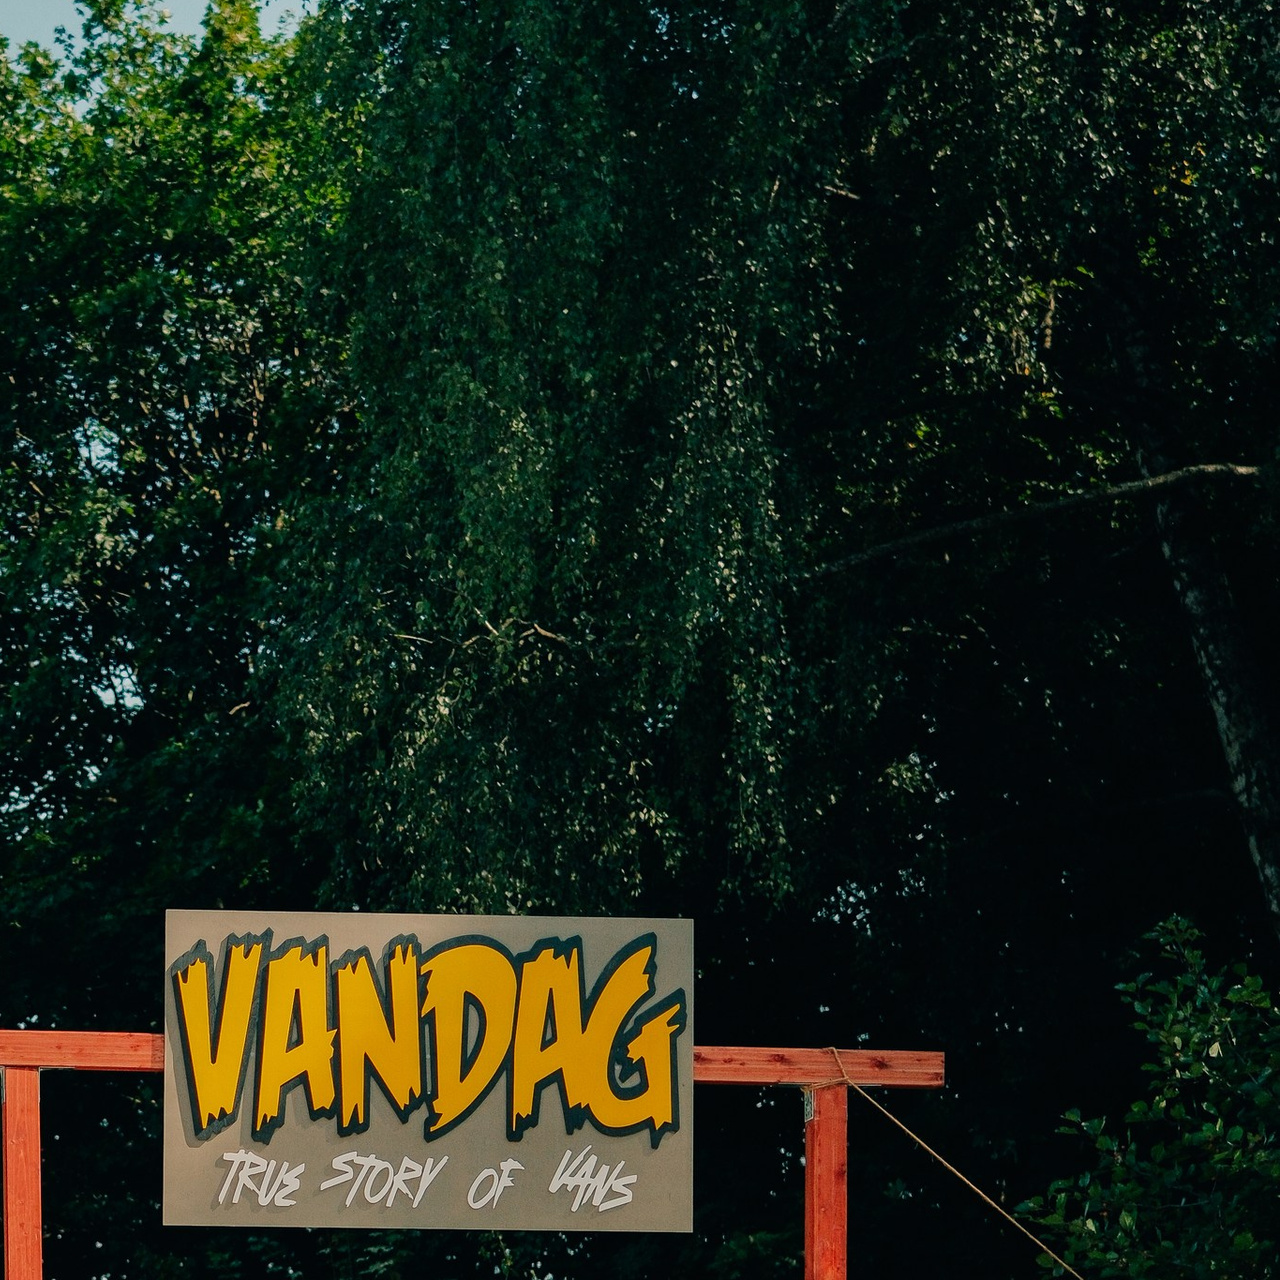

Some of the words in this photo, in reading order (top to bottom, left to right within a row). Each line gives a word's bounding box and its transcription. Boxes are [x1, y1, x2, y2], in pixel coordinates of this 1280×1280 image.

[169, 928, 687, 1149] VANDAG
[219, 1149, 305, 1208] TRUE
[320, 1151, 449, 1209] STORY
[467, 1158, 525, 1210] OF
[548, 1145, 639, 1212] VANS
